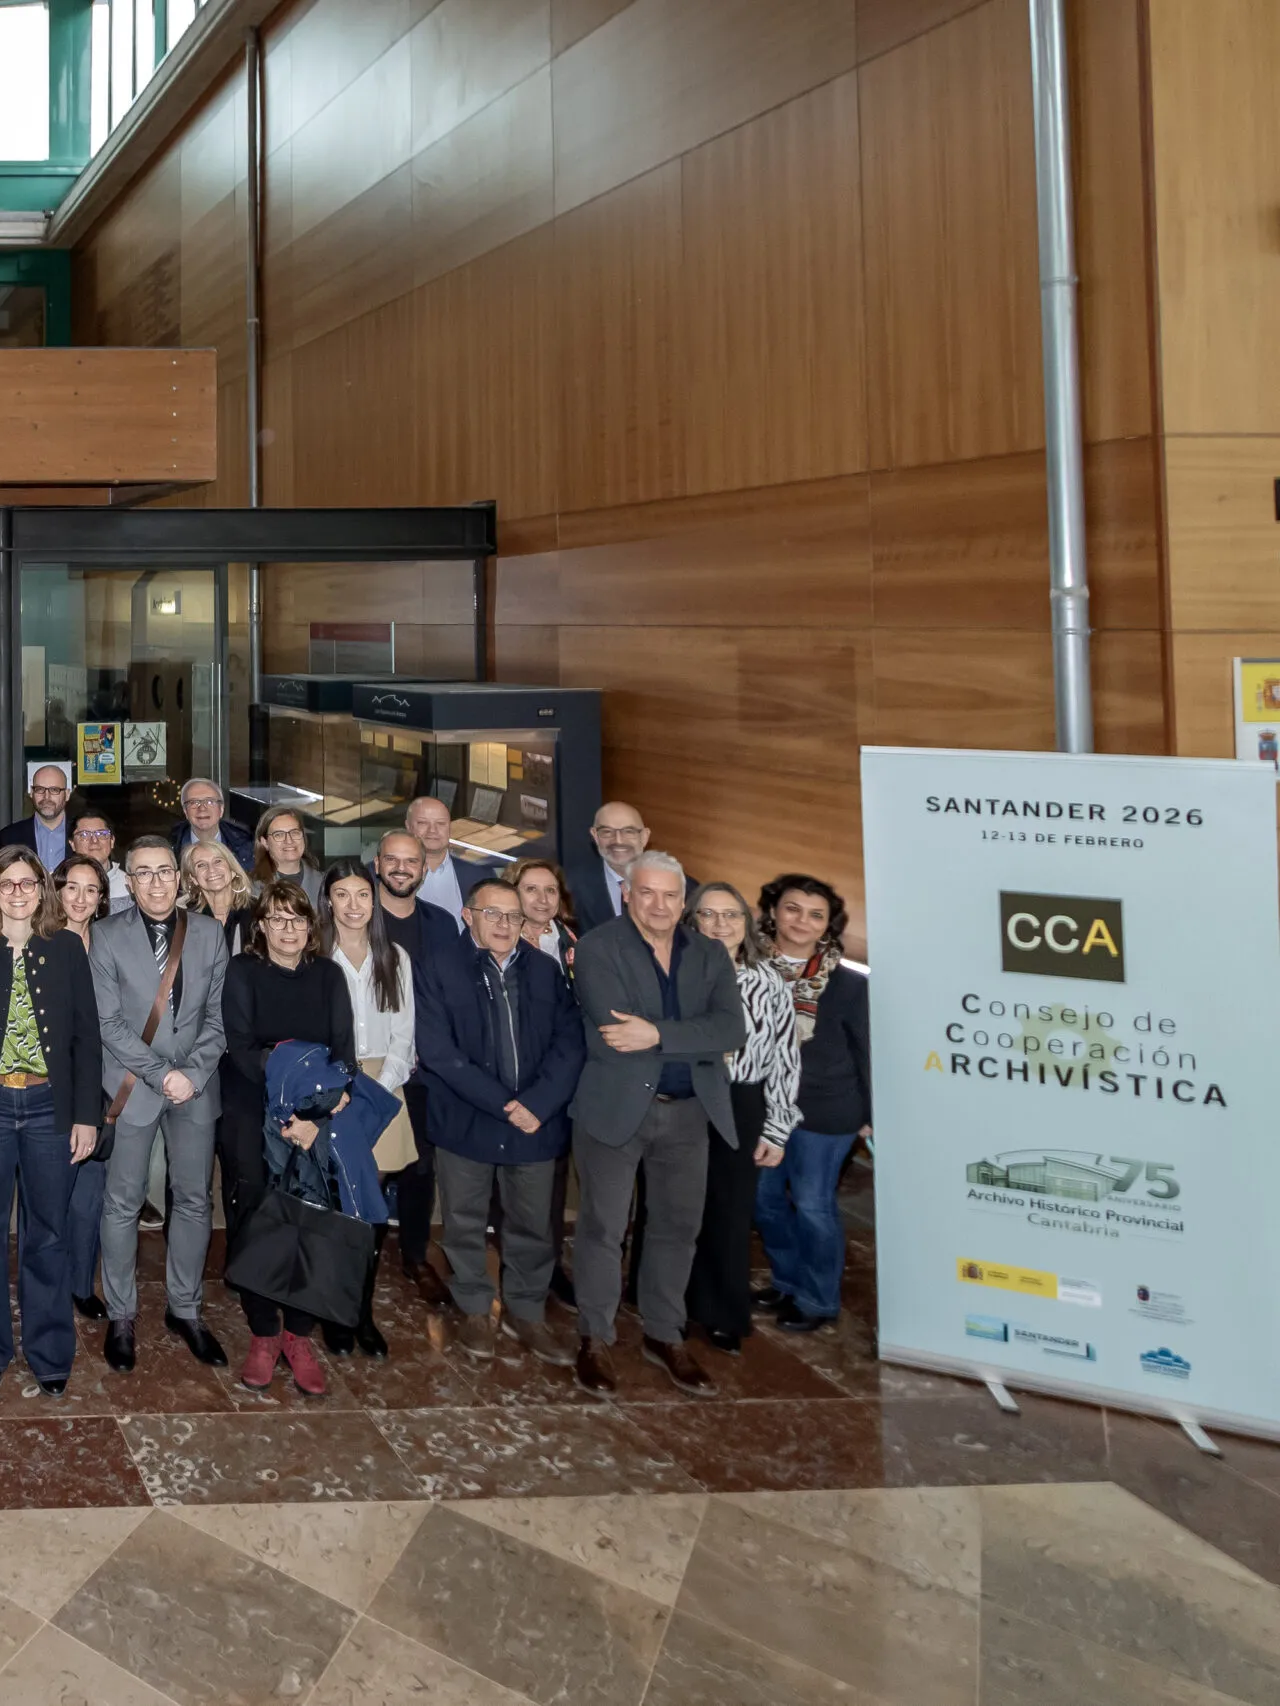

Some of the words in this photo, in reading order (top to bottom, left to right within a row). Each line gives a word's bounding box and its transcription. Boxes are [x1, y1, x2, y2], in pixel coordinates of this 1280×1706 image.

[925, 796, 1106, 821] SANTANDER
[1122, 805, 1204, 826] 2026
[981, 830, 1027, 842] 12-13
[1035, 833, 1056, 843] DE
[1064, 834, 1144, 848] FEBRERO
[1007, 912, 1119, 957] CCA
[961, 993, 1114, 1030] Consejo
[1133, 1012, 1176, 1035] de
[945, 1022, 1197, 1071] Cooperación
[923, 1050, 1228, 1107] ARCHIVÍSTICA
[1110, 1156, 1181, 1199] 75
[967, 1188, 1025, 1207] Archivo
[1030, 1198, 1101, 1219] Histórico
[1105, 1209, 1185, 1232] Provincial
[1027, 1212, 1120, 1238] Cantabria
